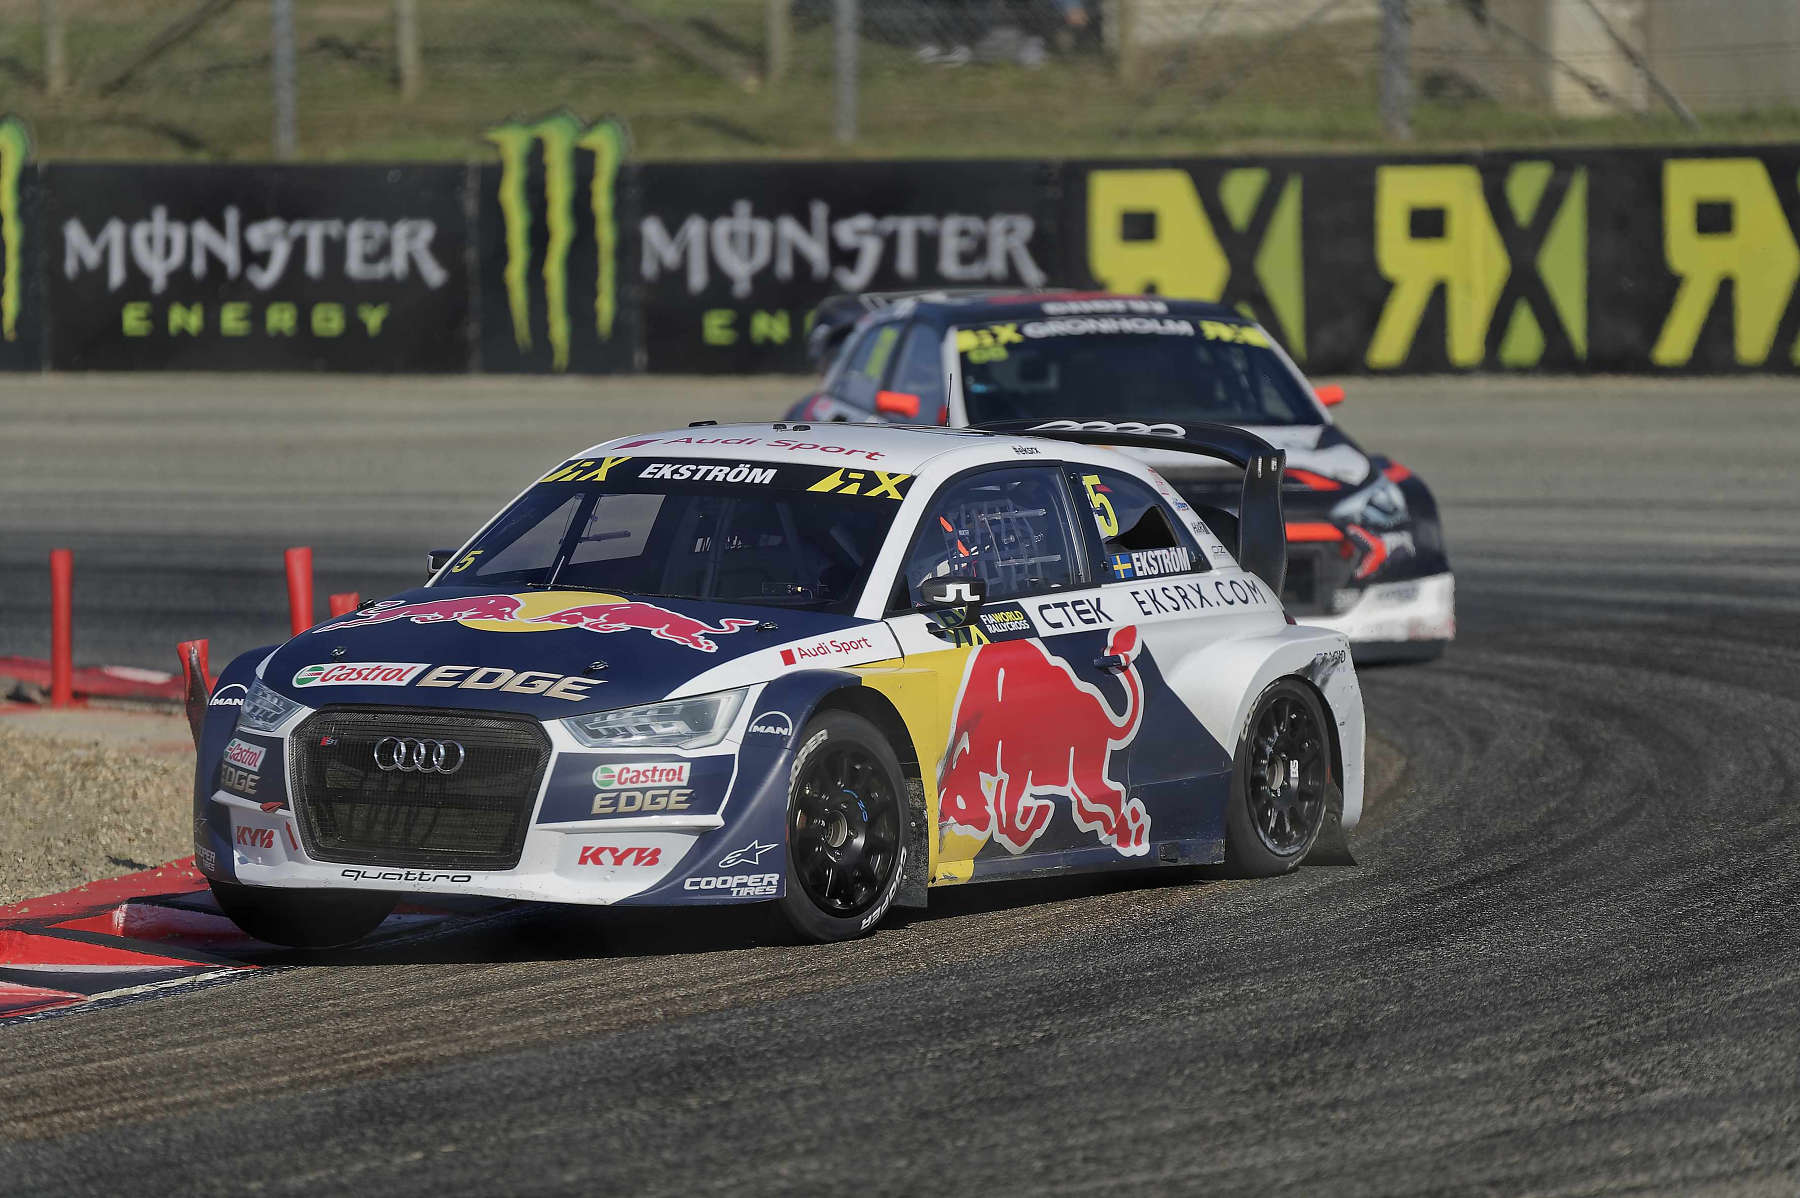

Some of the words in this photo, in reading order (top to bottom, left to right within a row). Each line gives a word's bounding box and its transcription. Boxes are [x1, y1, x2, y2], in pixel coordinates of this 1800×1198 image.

[63, 204, 448, 293] MONSTER
[640, 198, 1047, 297] MONSTER
[1650, 157, 1800, 366] R
[121, 303, 389, 337] ENERGY
[702, 308, 816, 346] EN
[663, 437, 762, 445] Audi
[766, 438, 886, 461] Sport
[638, 463, 777, 484] EKSTRÖM
[1082, 474, 1119, 537] 5
[451, 550, 484, 573] 5
[1131, 546, 1191, 577] EKSTRÖM
[1130, 579, 1266, 616] EKSRX.COM
[1038, 597, 1114, 629] CTEK
[986, 620, 1030, 634] RALLYCROSS
[798, 642, 829, 660] Audi
[829, 635, 872, 656] Sport
[320, 664, 418, 682] Castrol
[416, 665, 609, 701] EDGE
[213, 698, 246, 706] MAN
[752, 724, 790, 735] MAN
[228, 743, 262, 768] Castrol
[617, 765, 684, 785] Castrol
[591, 788, 695, 815] EDGE
[235, 825, 275, 849] KYB
[577, 845, 662, 867] KYB
[340, 869, 473, 884] quattro
[684, 873, 780, 890] COOPER
[730, 886, 778, 897] TIRES
